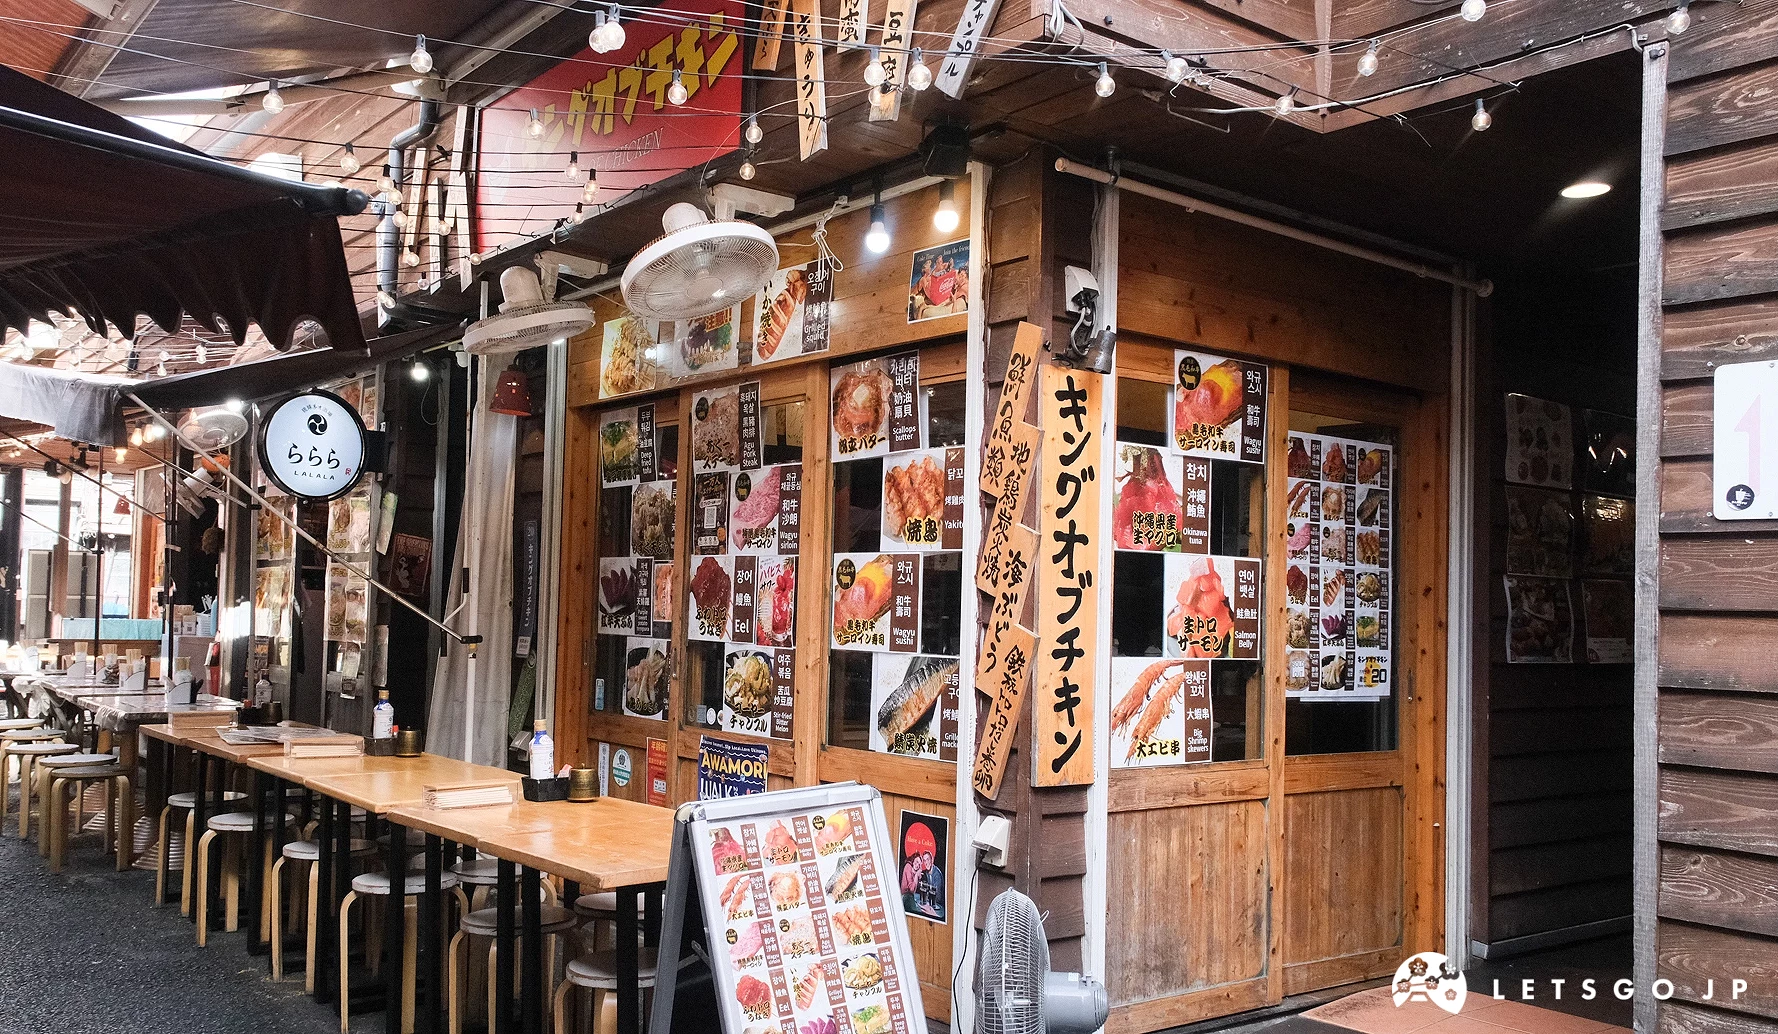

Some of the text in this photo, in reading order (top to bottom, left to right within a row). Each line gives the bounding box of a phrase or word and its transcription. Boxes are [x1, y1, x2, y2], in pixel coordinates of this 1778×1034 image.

[811, 281, 825, 295] 구이
[1246, 370, 1261, 384] 와규
[1247, 383, 1262, 395] 스시
[1247, 404, 1260, 416] 和牛
[893, 426, 916, 435] Scallops
[896, 433, 913, 441] butter
[1244, 436, 1261, 448] Wagyu
[288, 442, 340, 470] ららら
[744, 449, 756, 458] Pork
[1246, 446, 1260, 455] sushi
[743, 458, 758, 467] Steak
[294, 470, 335, 480] LALALA
[1186, 463, 1206, 481] 참치
[782, 499, 798, 511] 和牛
[780, 531, 797, 540] Wagyu
[1183, 527, 1207, 537] Okinawa
[781, 541, 797, 549] sirloin
[1189, 537, 1202, 545] tuna
[897, 561, 913, 574] 와규
[737, 569, 752, 584] 장어
[897, 573, 913, 586] 스시
[1051, 375, 1095, 774] キングオブチキン
[1238, 570, 1254, 583] 연어
[1239, 585, 1255, 598] 뱃살
[896, 595, 911, 606] 和牛
[735, 619, 749, 633] Eel
[1184, 616, 1217, 633] 生トロ
[893, 628, 915, 639] Wagyu
[1235, 631, 1256, 640] Salmon
[895, 636, 913, 645] sushi
[1178, 635, 1223, 652] サーモン
[1239, 639, 1253, 650] Belly
[778, 654, 790, 666] 여주
[1185, 671, 1207, 684] 왕새우
[1372, 669, 1387, 683] 20
[1190, 684, 1204, 698] 꼬치
[1194, 728, 1203, 737] Big
[1188, 736, 1207, 746] Shrimp
[1136, 741, 1180, 757] 大エビ串
[1187, 745, 1208, 753] skewers
[701, 750, 767, 779] AWAMORI
[701, 778, 732, 799] WALK
[779, 1004, 790, 1012] Eel
